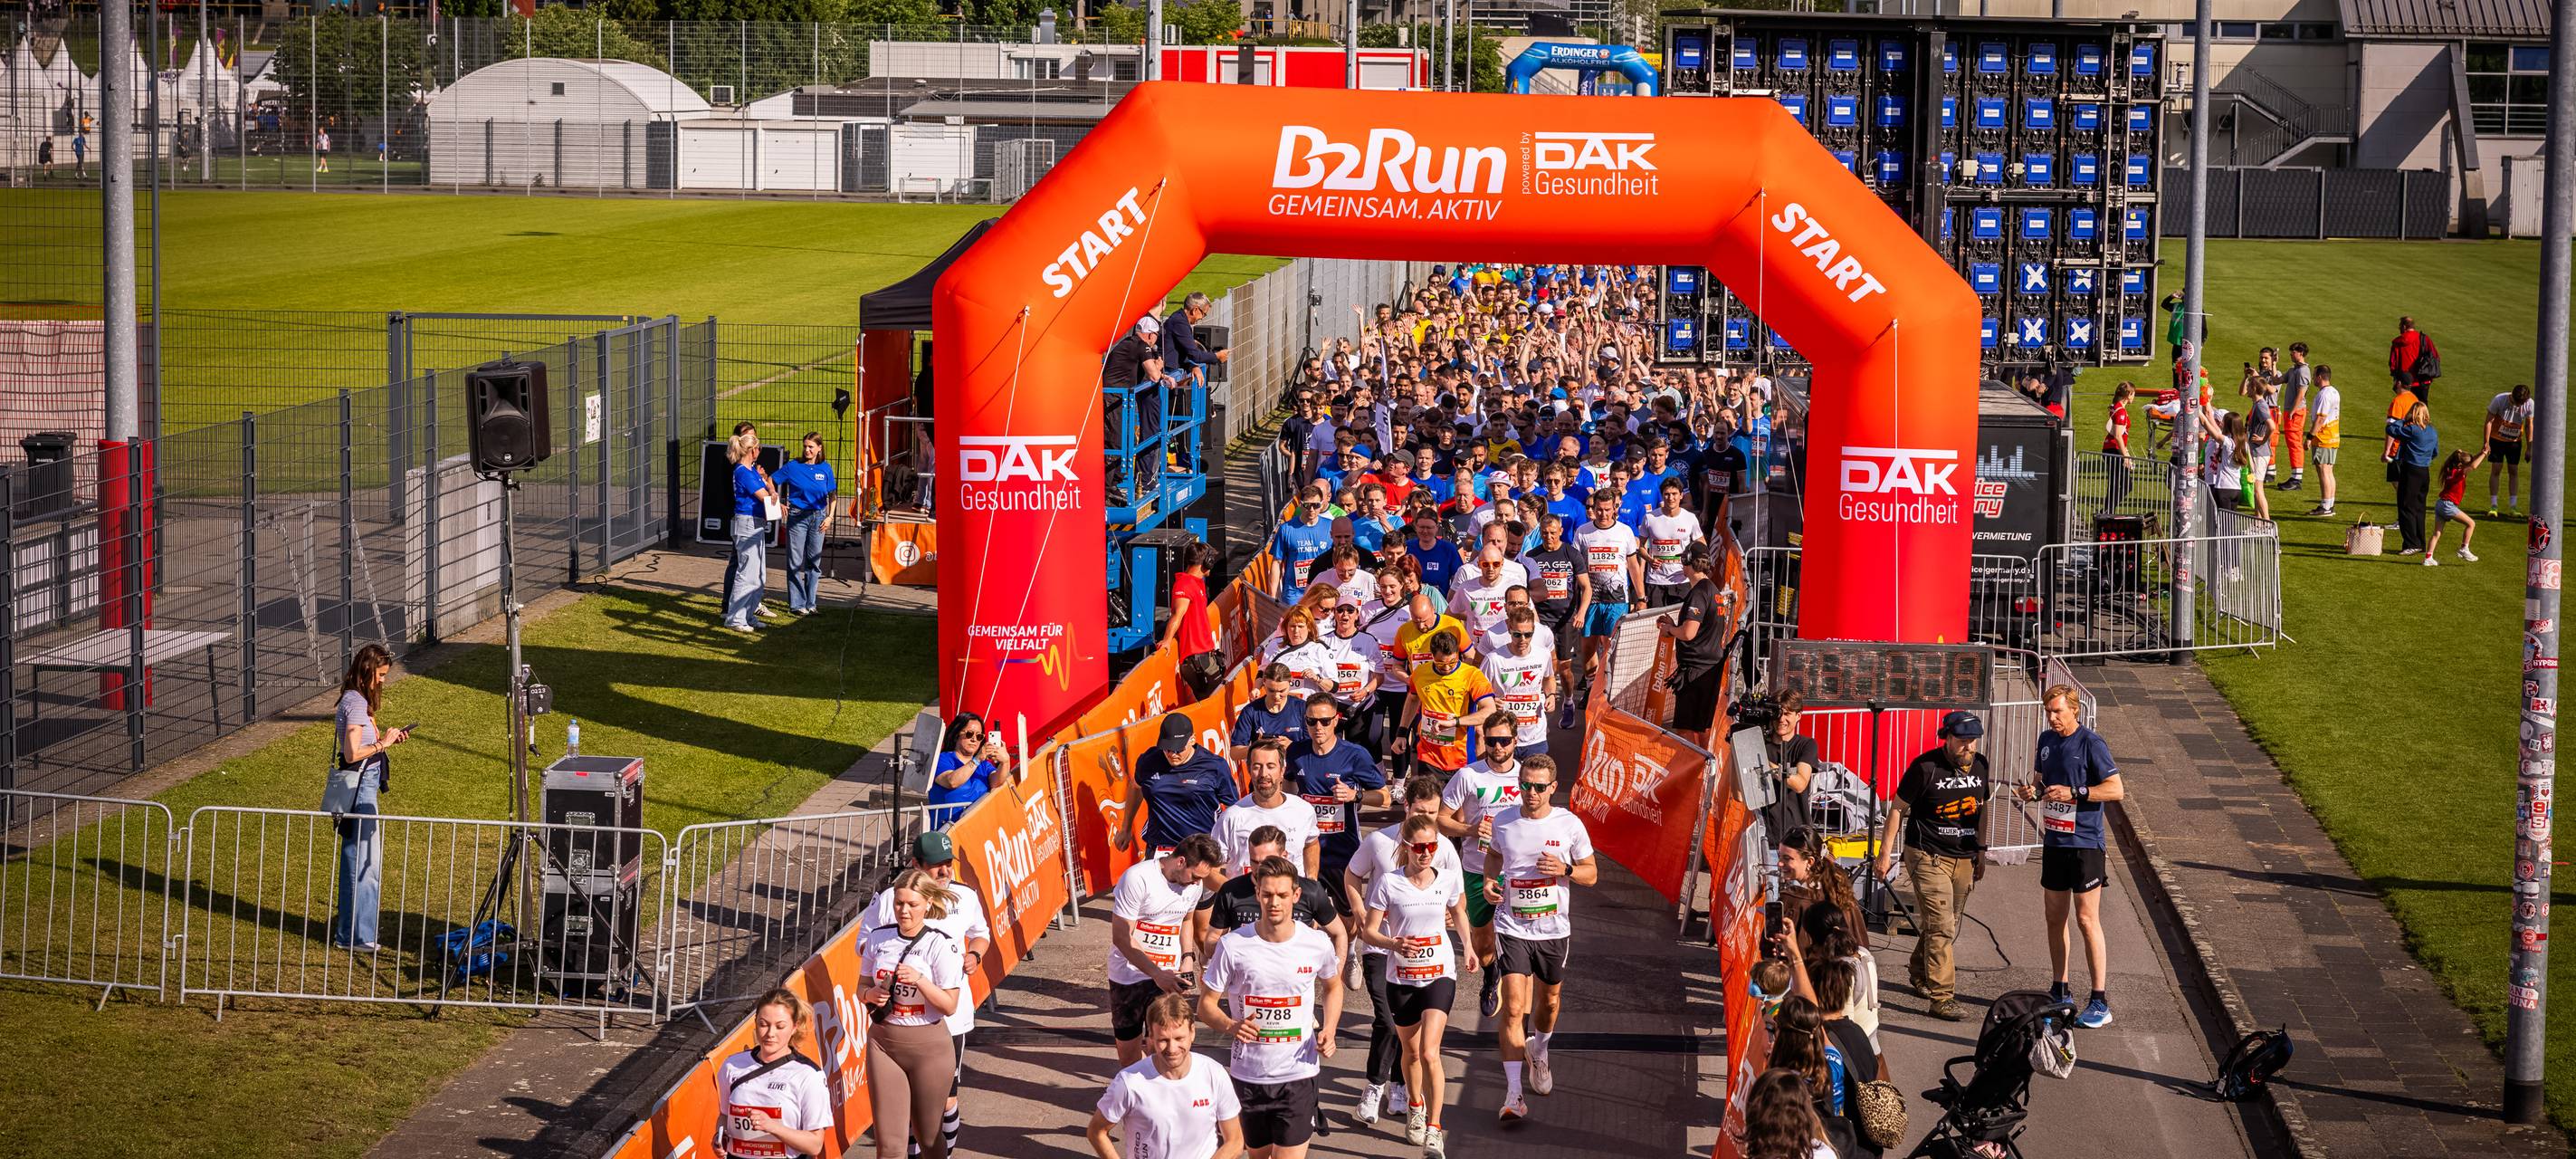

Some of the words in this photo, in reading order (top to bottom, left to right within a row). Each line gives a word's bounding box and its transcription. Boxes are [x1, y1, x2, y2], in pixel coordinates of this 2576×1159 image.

[1550, 57, 1609, 66] ALKOHOLFREI
[1551, 45, 1598, 59] ERDINGER
[1522, 131, 1531, 145] by
[1272, 125, 1507, 194] B2Run
[1535, 132, 1658, 170] DAK
[1522, 148, 1531, 195] powered
[1535, 171, 1658, 196] Gesundheit
[1042, 187, 1146, 298] START
[1771, 202, 1887, 303] START
[959, 436, 1080, 482] DAK
[1840, 446, 1959, 495] DAK
[960, 483, 1082, 510] Gesundheit
[1839, 493, 1958, 524] Gesundheit
[1591, 552, 1616, 560] 11825
[968, 624, 1037, 637] GEMEINSAM
[1040, 622, 1063, 637] FÜR
[996, 638, 1048, 651] VIELFALT
[1508, 703, 1537, 711] 10752
[1632, 752, 1670, 804] DAK
[1025, 789, 1054, 840] DAK
[984, 826, 1035, 910] B2Run
[1518, 888, 1549, 899] 5864
[1142, 934, 1172, 946] 1211
[1297, 966, 1312, 974] ABB
[1255, 1008, 1292, 1020] 5788
[1193, 1098, 1209, 1107] ABB
